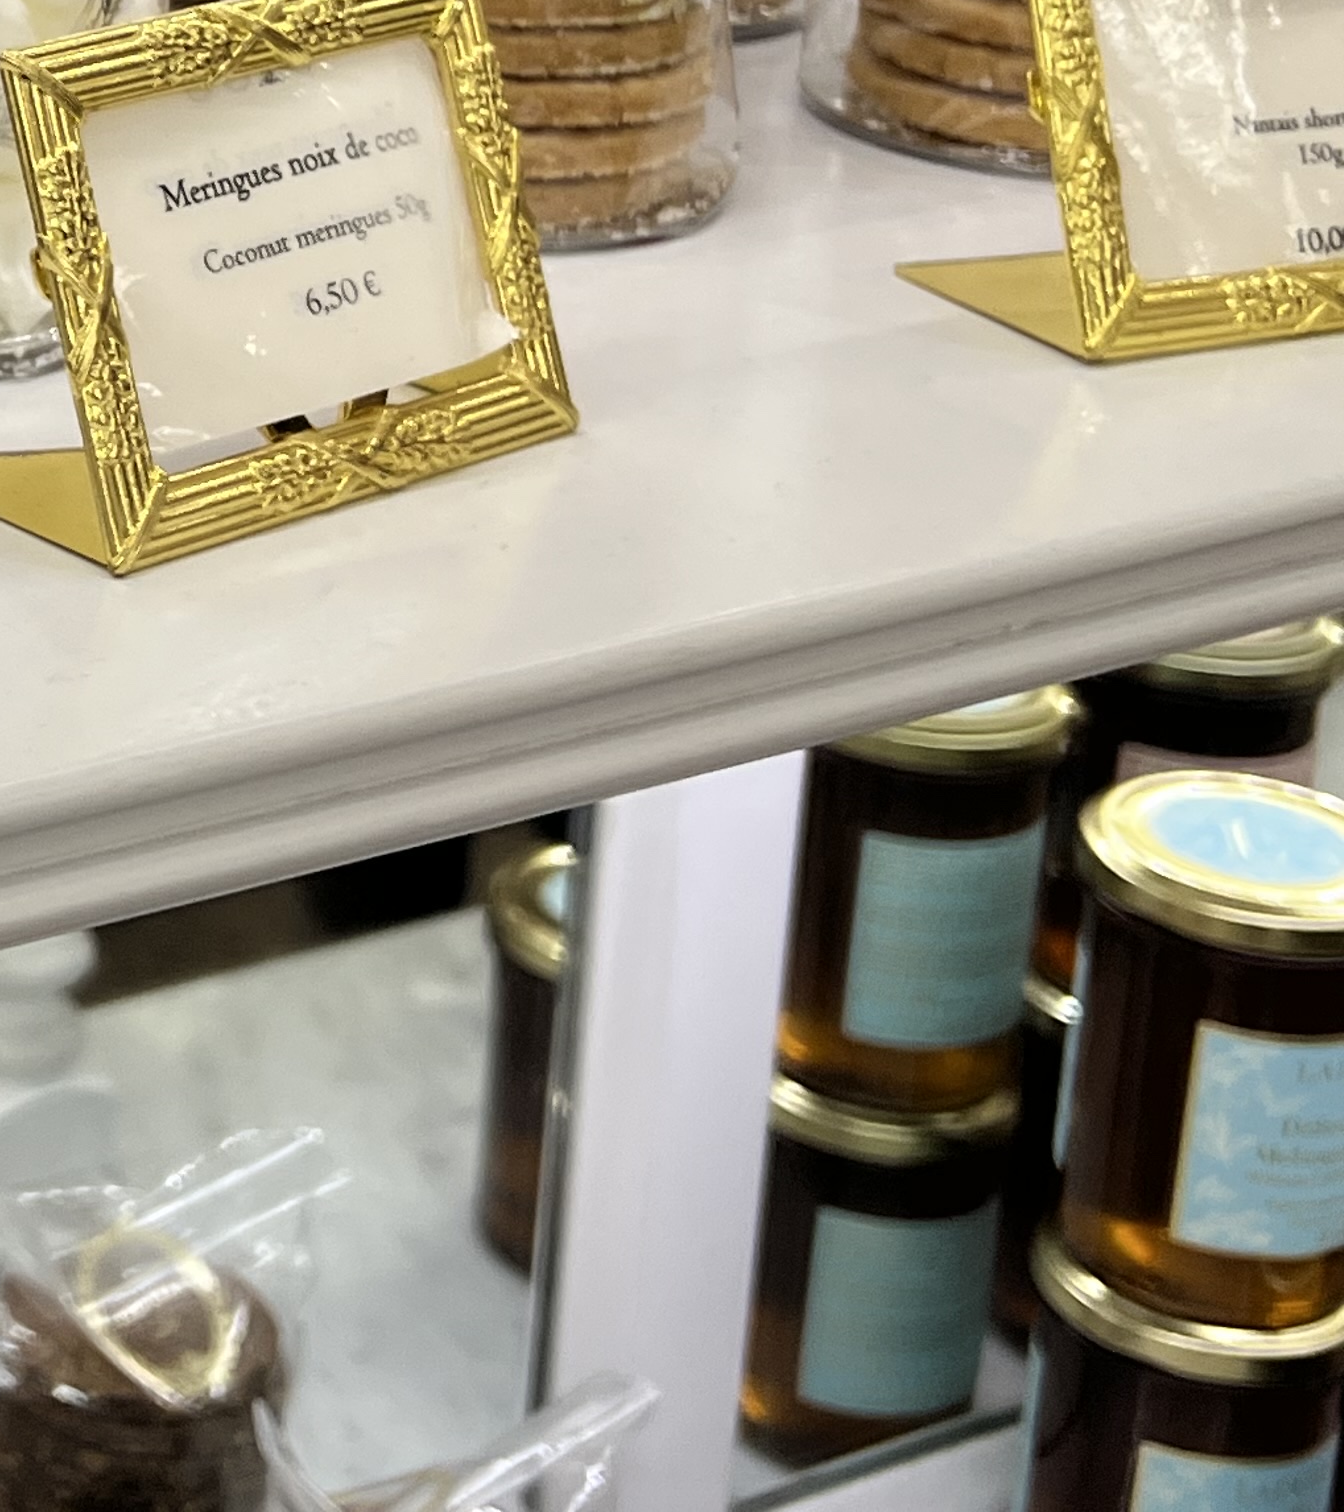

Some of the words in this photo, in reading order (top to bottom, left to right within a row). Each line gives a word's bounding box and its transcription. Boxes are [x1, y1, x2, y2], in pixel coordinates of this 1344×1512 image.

[156, 162, 284, 213] Meringues
[287, 141, 341, 177] noix
[344, 131, 371, 160] de
[374, 125, 420, 153] coco
[202, 234, 292, 274] Coconut
[294, 208, 393, 249] meringues
[1297, 225, 1344, 256] 10,0
[305, 277, 360, 317] 6,50
[362, 269, 383, 297] €
